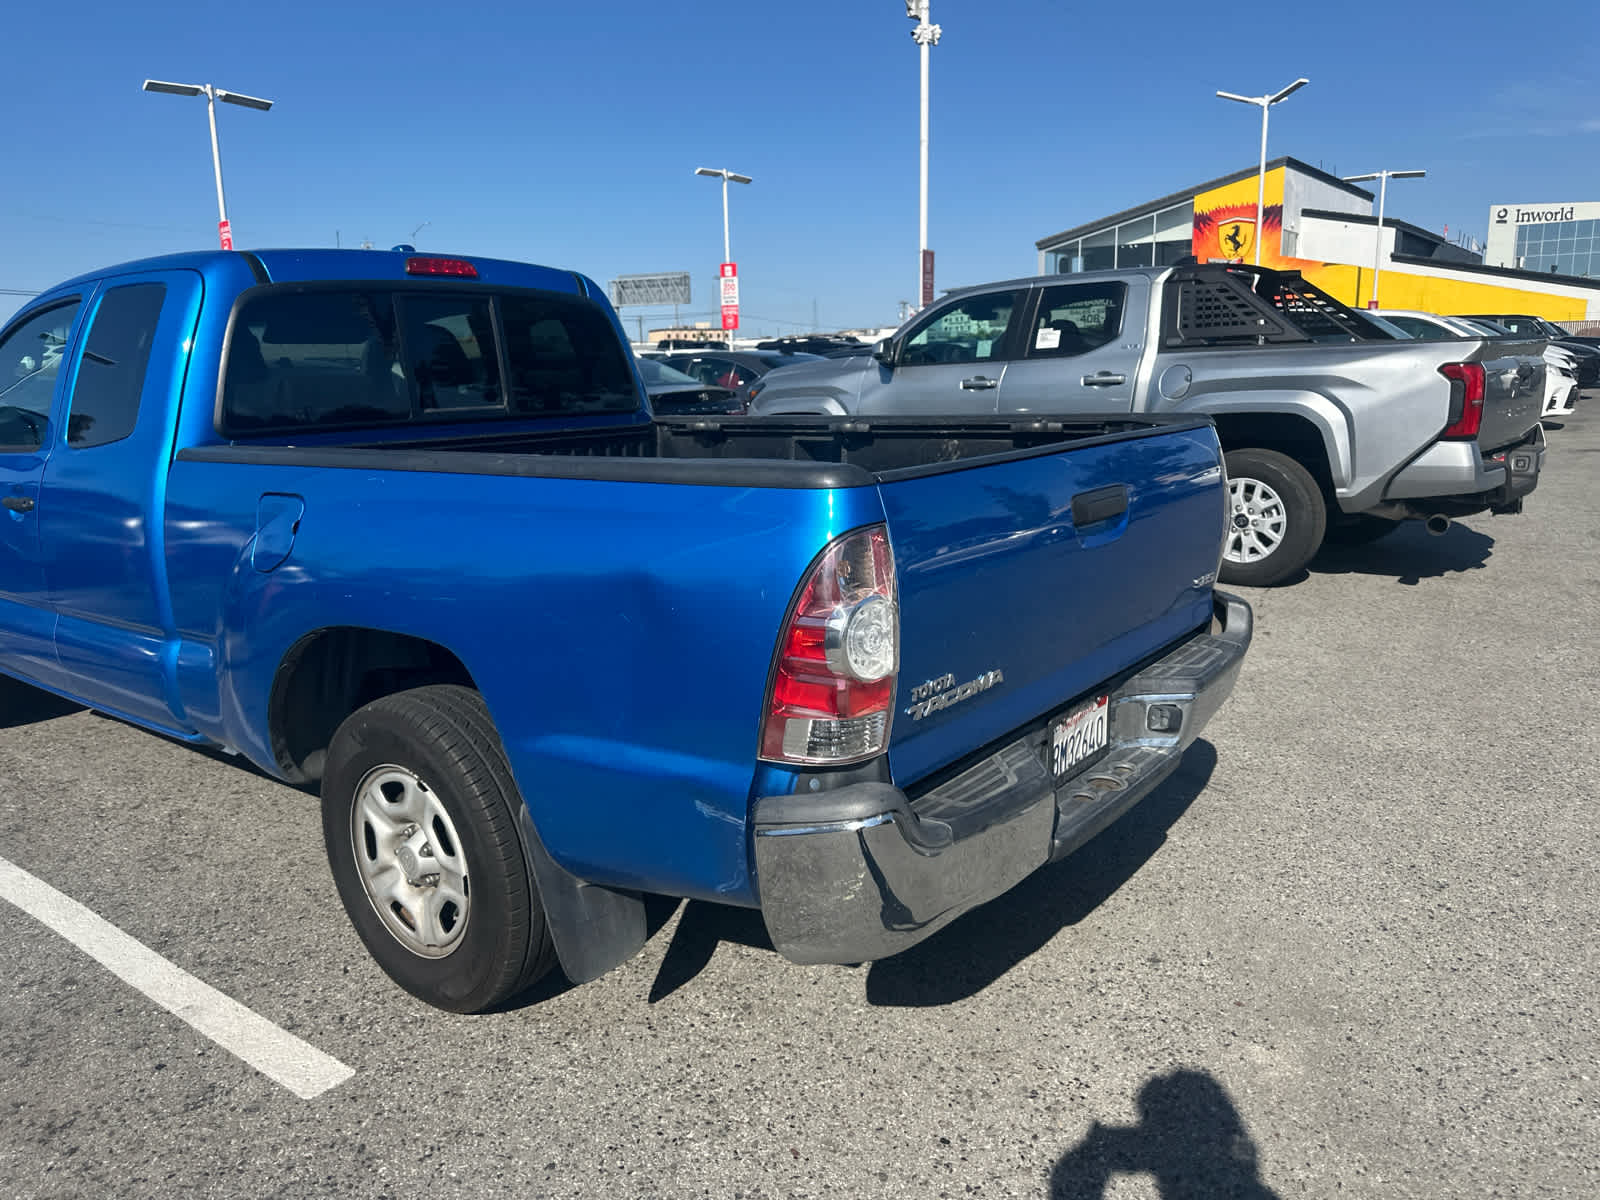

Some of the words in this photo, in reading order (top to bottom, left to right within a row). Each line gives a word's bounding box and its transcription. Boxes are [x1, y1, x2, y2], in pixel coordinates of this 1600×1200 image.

[1515, 206, 1575, 223] Inworld
[904, 668, 1004, 721] TACOMA
[911, 673, 955, 702] TOYOTA
